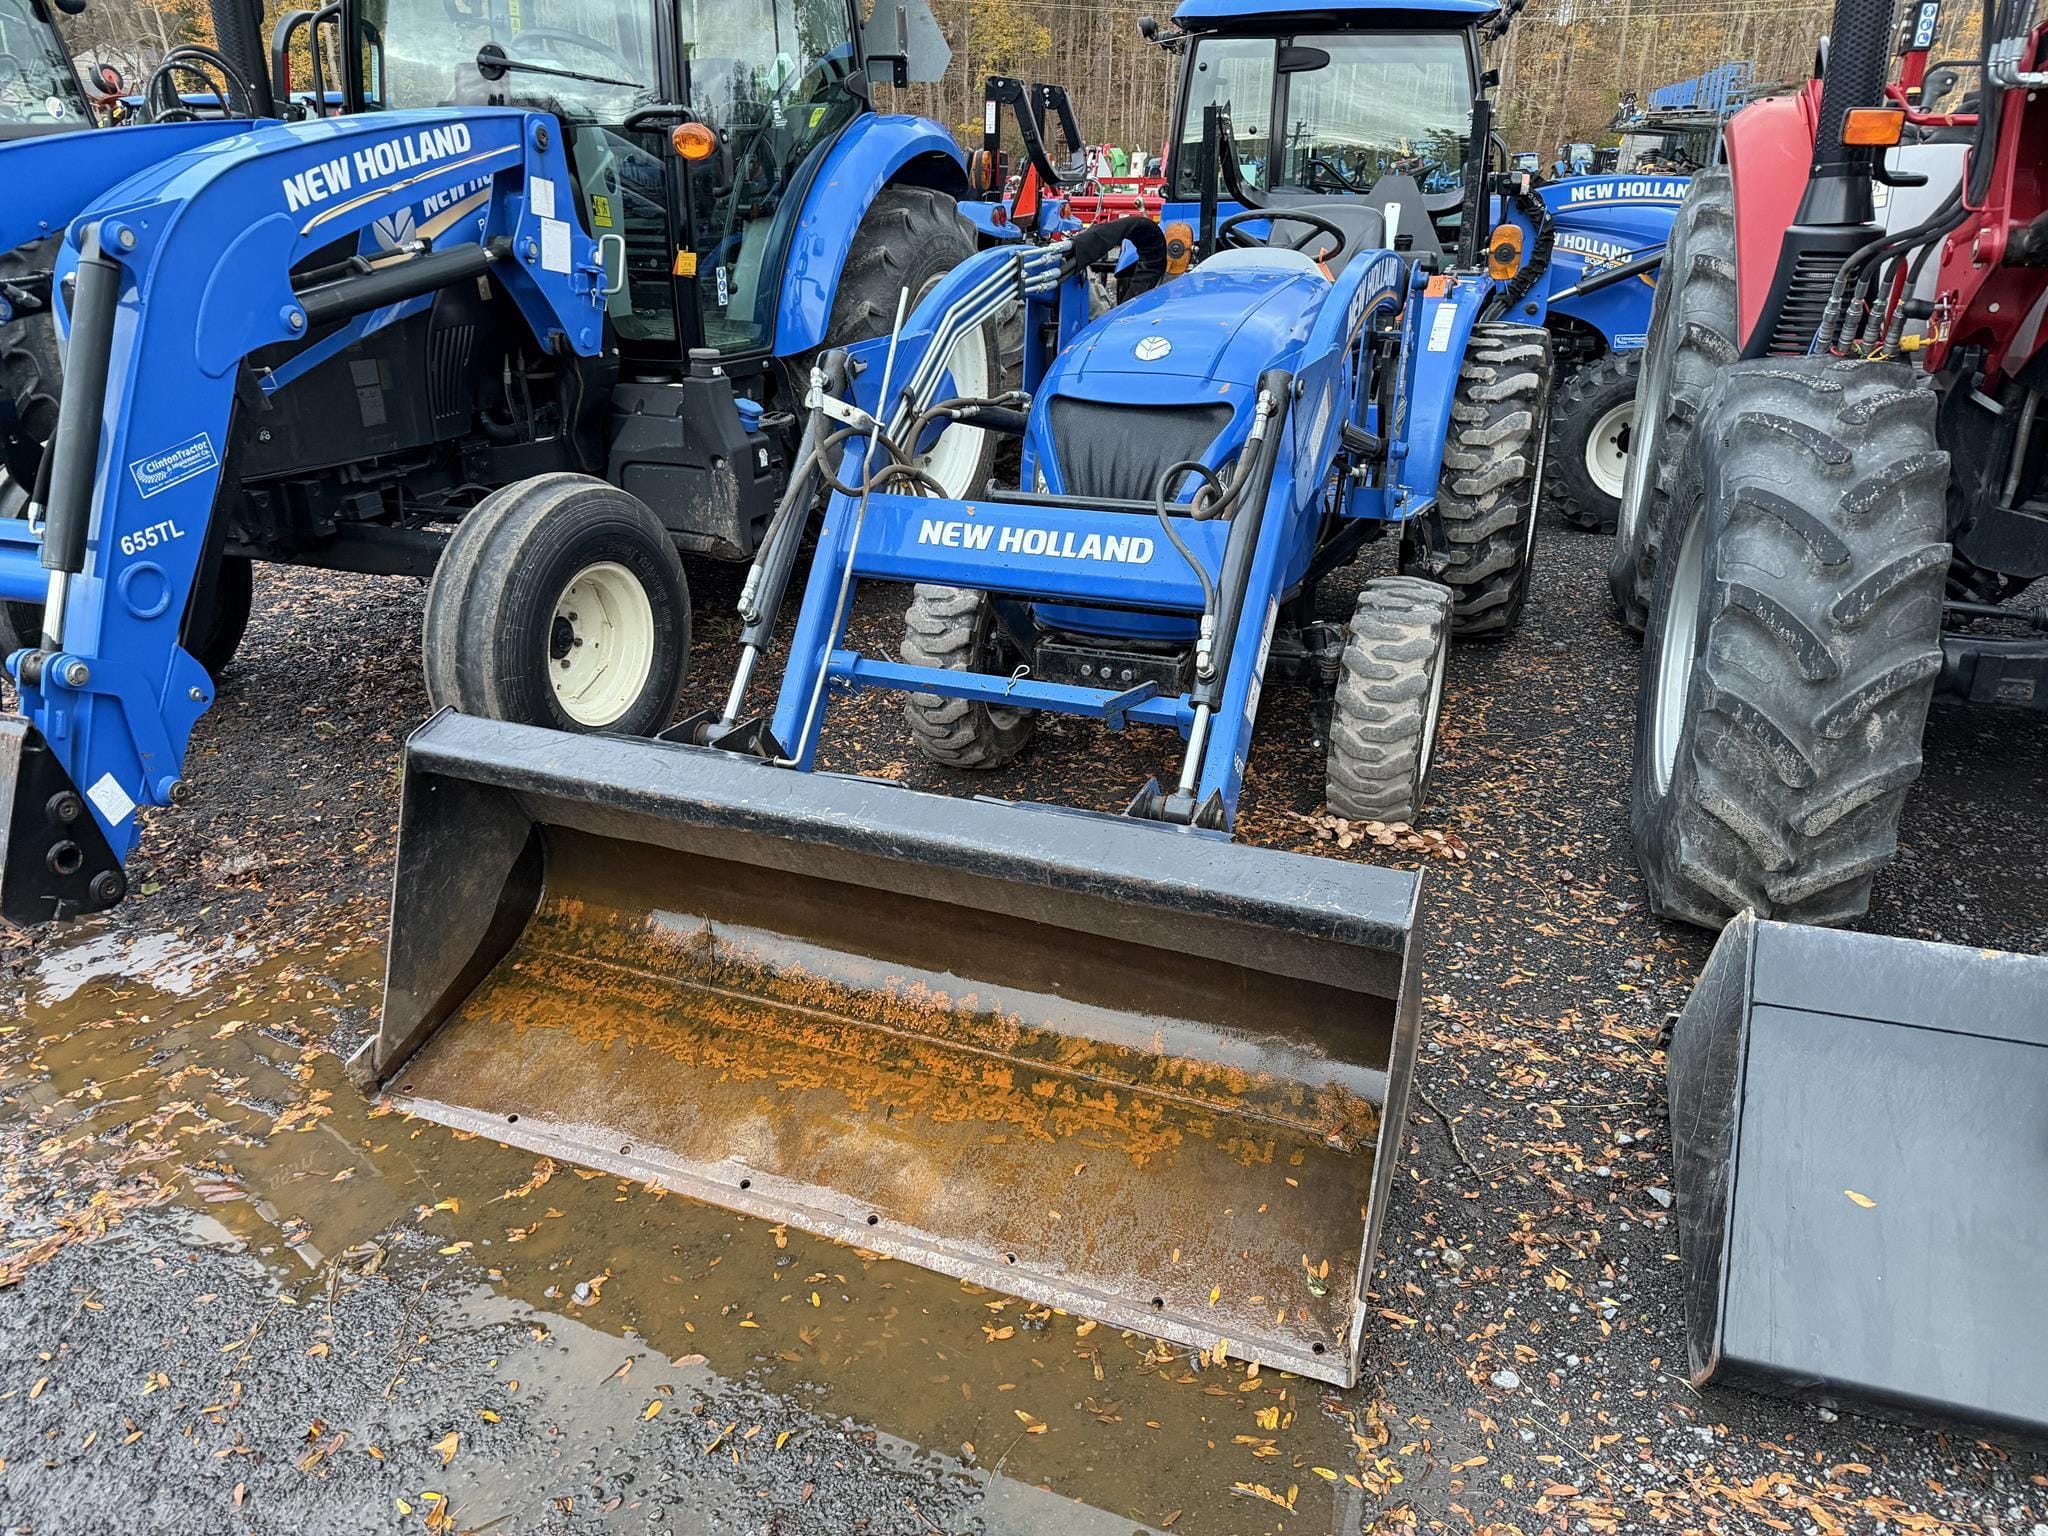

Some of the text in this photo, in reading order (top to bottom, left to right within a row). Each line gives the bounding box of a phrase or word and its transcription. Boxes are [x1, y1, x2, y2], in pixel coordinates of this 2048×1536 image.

[282, 123, 471, 212] NEW HOLLAND
[1571, 183, 1614, 202] NEW
[1563, 234, 1633, 264] HOLLAND
[146, 441, 208, 473] ClintonTractor
[121, 519, 185, 556] 655TL
[918, 519, 1154, 564] NEW HOLLAND
